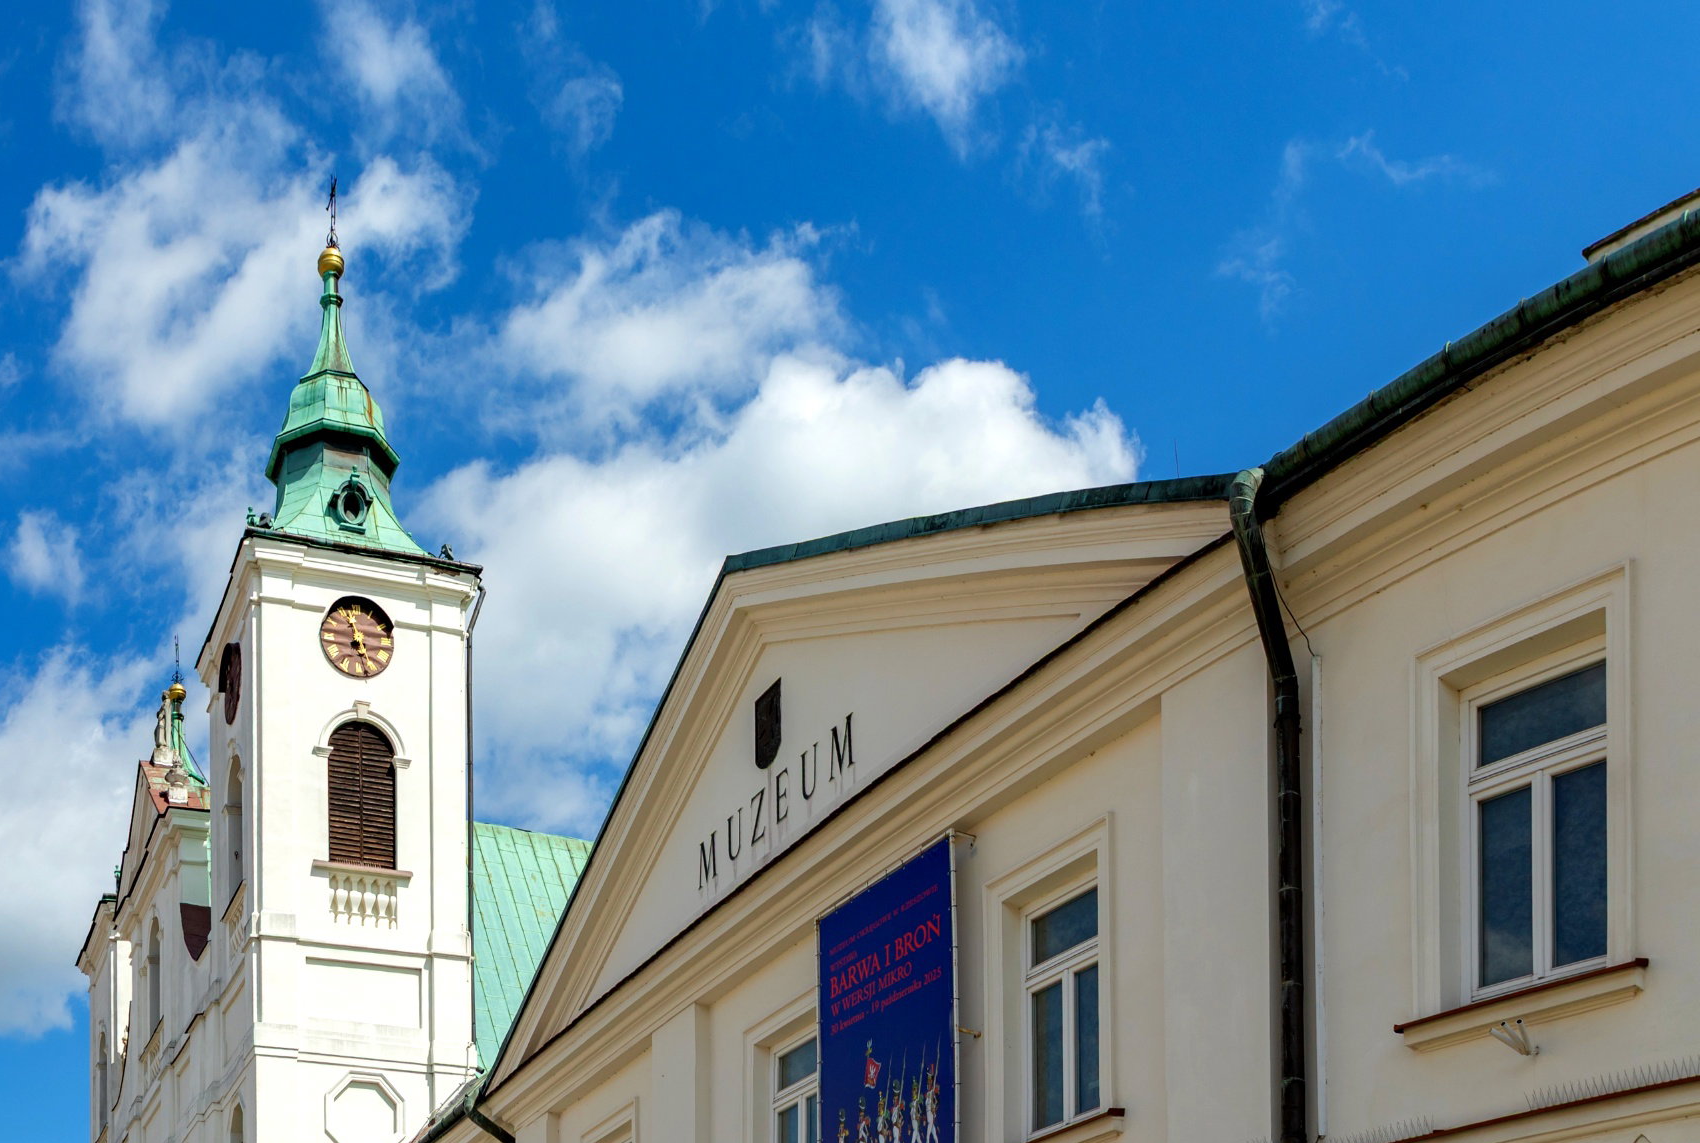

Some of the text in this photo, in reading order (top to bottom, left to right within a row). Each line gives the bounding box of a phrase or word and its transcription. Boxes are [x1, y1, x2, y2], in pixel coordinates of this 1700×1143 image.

[698, 712, 855, 890] MUZEUM
[830, 913, 941, 999] BARWA I BROŃ
[831, 961, 912, 1017] W WERSJI MIKRO
[871, 1000, 879, 1014] 19
[924, 966, 942, 985] 2025
